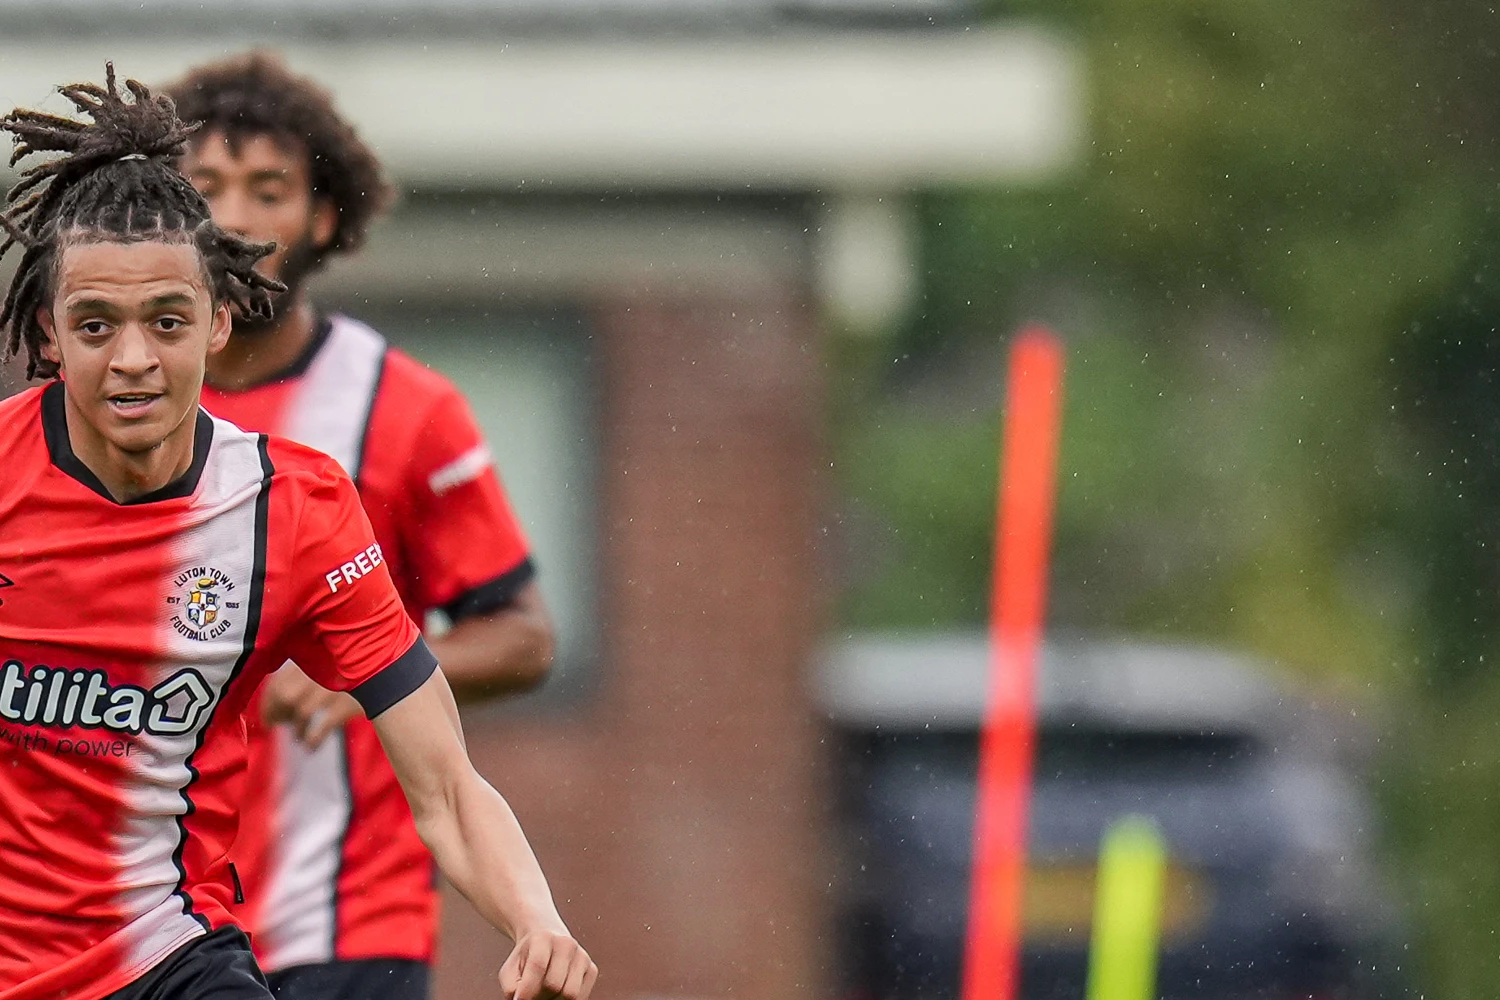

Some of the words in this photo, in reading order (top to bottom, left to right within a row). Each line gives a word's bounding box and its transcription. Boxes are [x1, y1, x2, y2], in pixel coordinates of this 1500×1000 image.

[173, 566, 206, 588] LUTON
[209, 567, 235, 591] TOWN
[169, 615, 208, 642] FOOTBALL
[210, 619, 232, 639] CLUB
[0, 726, 48, 752] with
[54, 737, 136, 758] power
